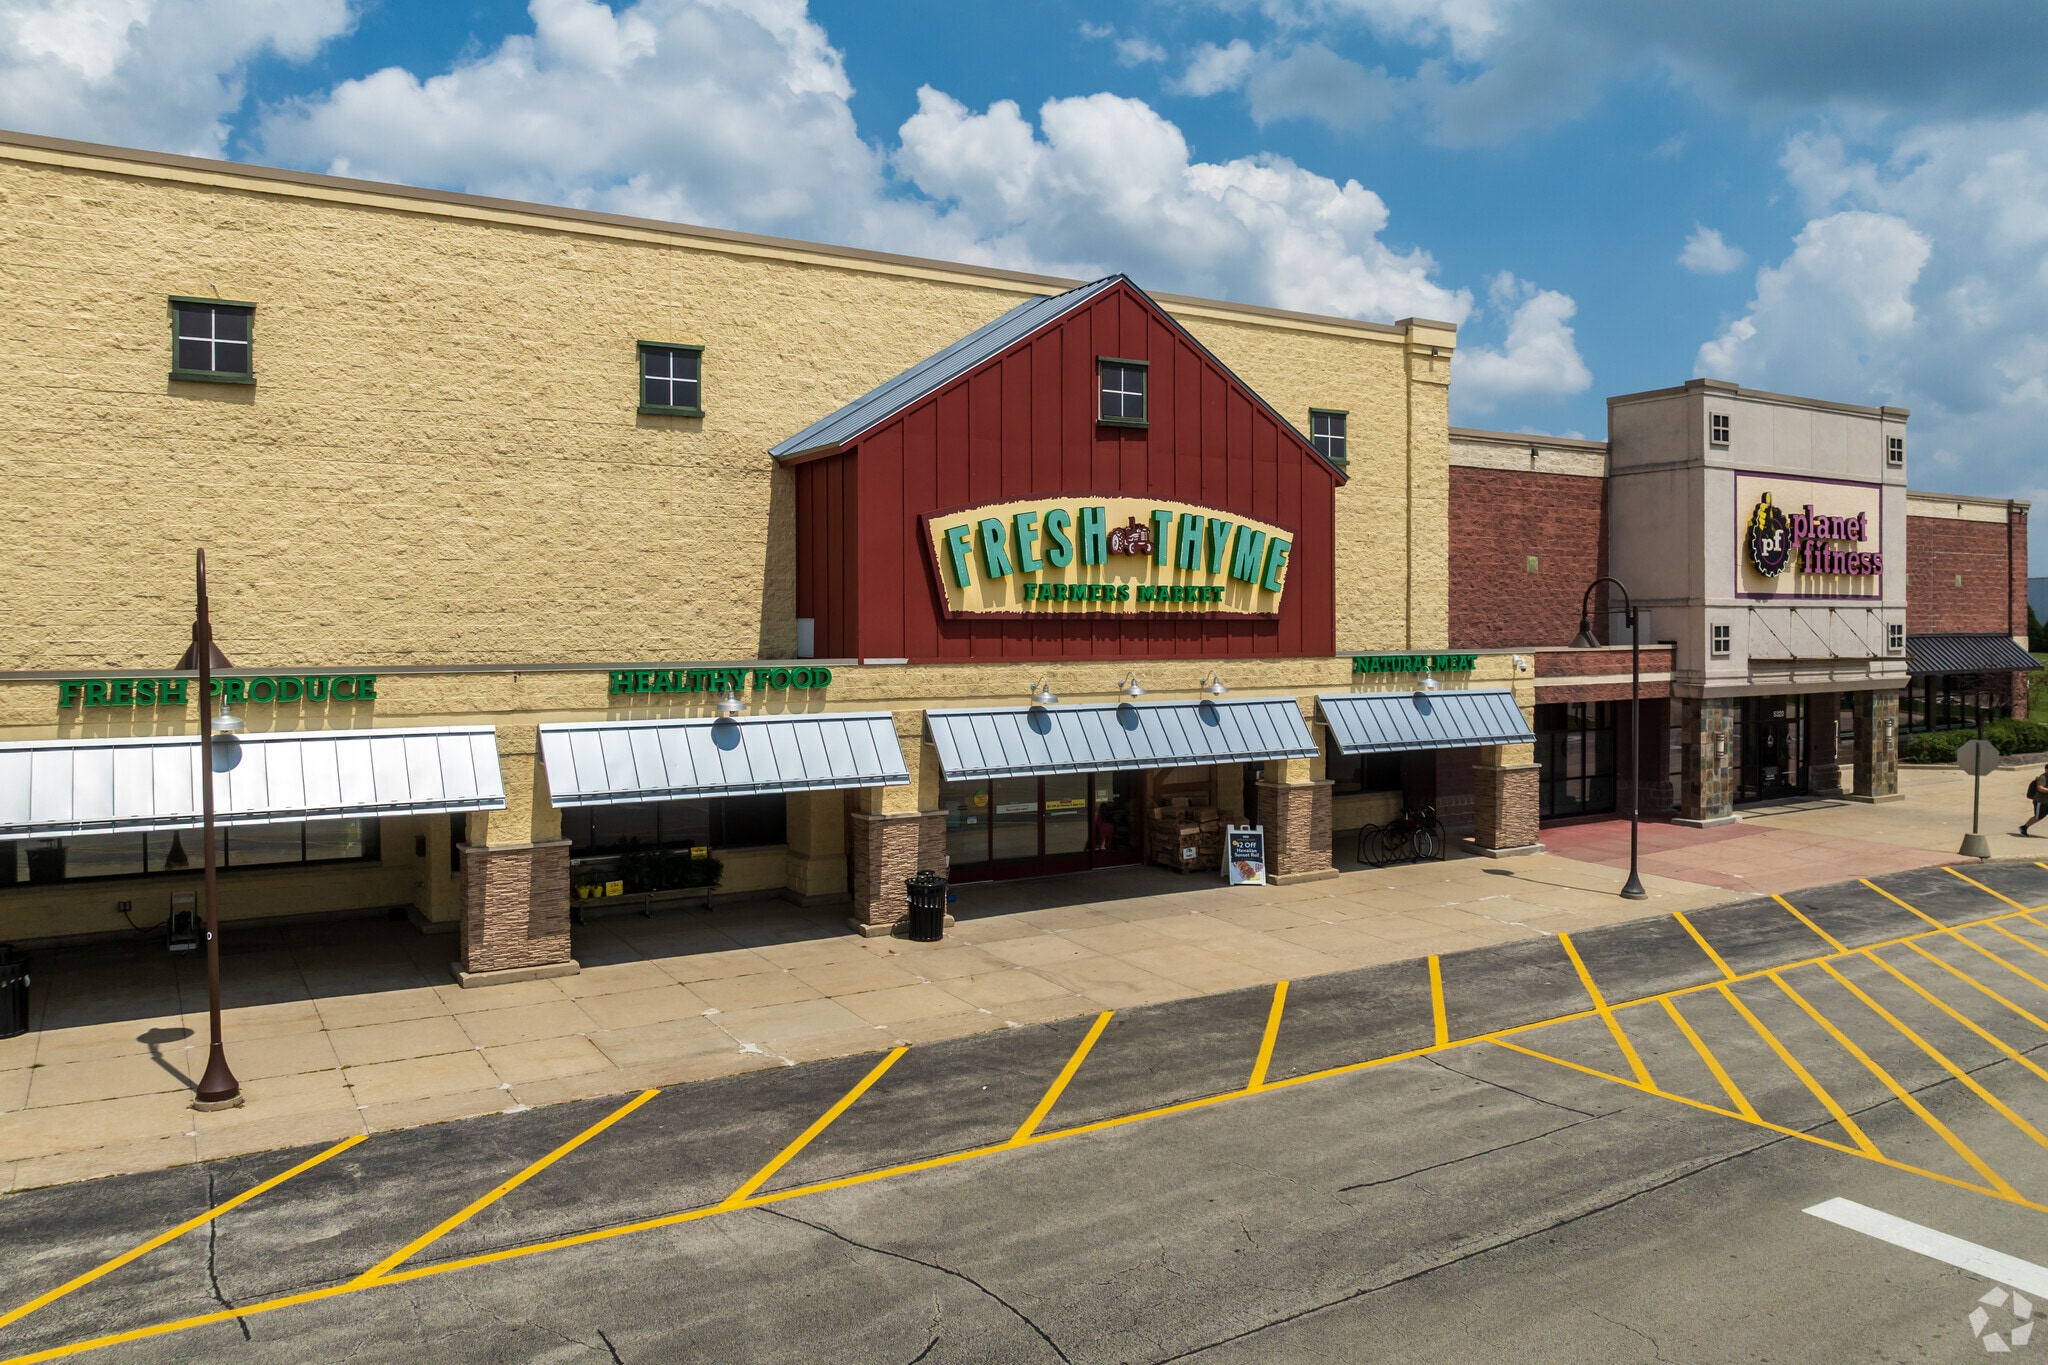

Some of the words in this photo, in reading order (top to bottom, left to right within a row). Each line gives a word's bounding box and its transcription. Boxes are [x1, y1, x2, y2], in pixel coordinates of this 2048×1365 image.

[1789, 504, 1868, 548] planet
[944, 506, 1109, 588] FRESH
[1151, 509, 1291, 593] THYME
[1761, 529, 1784, 556] pf
[1801, 539, 1884, 576] fitness
[1024, 583, 1130, 602] FARMERS
[1137, 584, 1225, 603] MARKET
[1353, 655, 1433, 674] NATURAL
[1435, 654, 1478, 671] MEAT
[58, 677, 189, 708] FRESH
[610, 668, 749, 694] HEALTHY
[754, 666, 832, 691] FOOD
